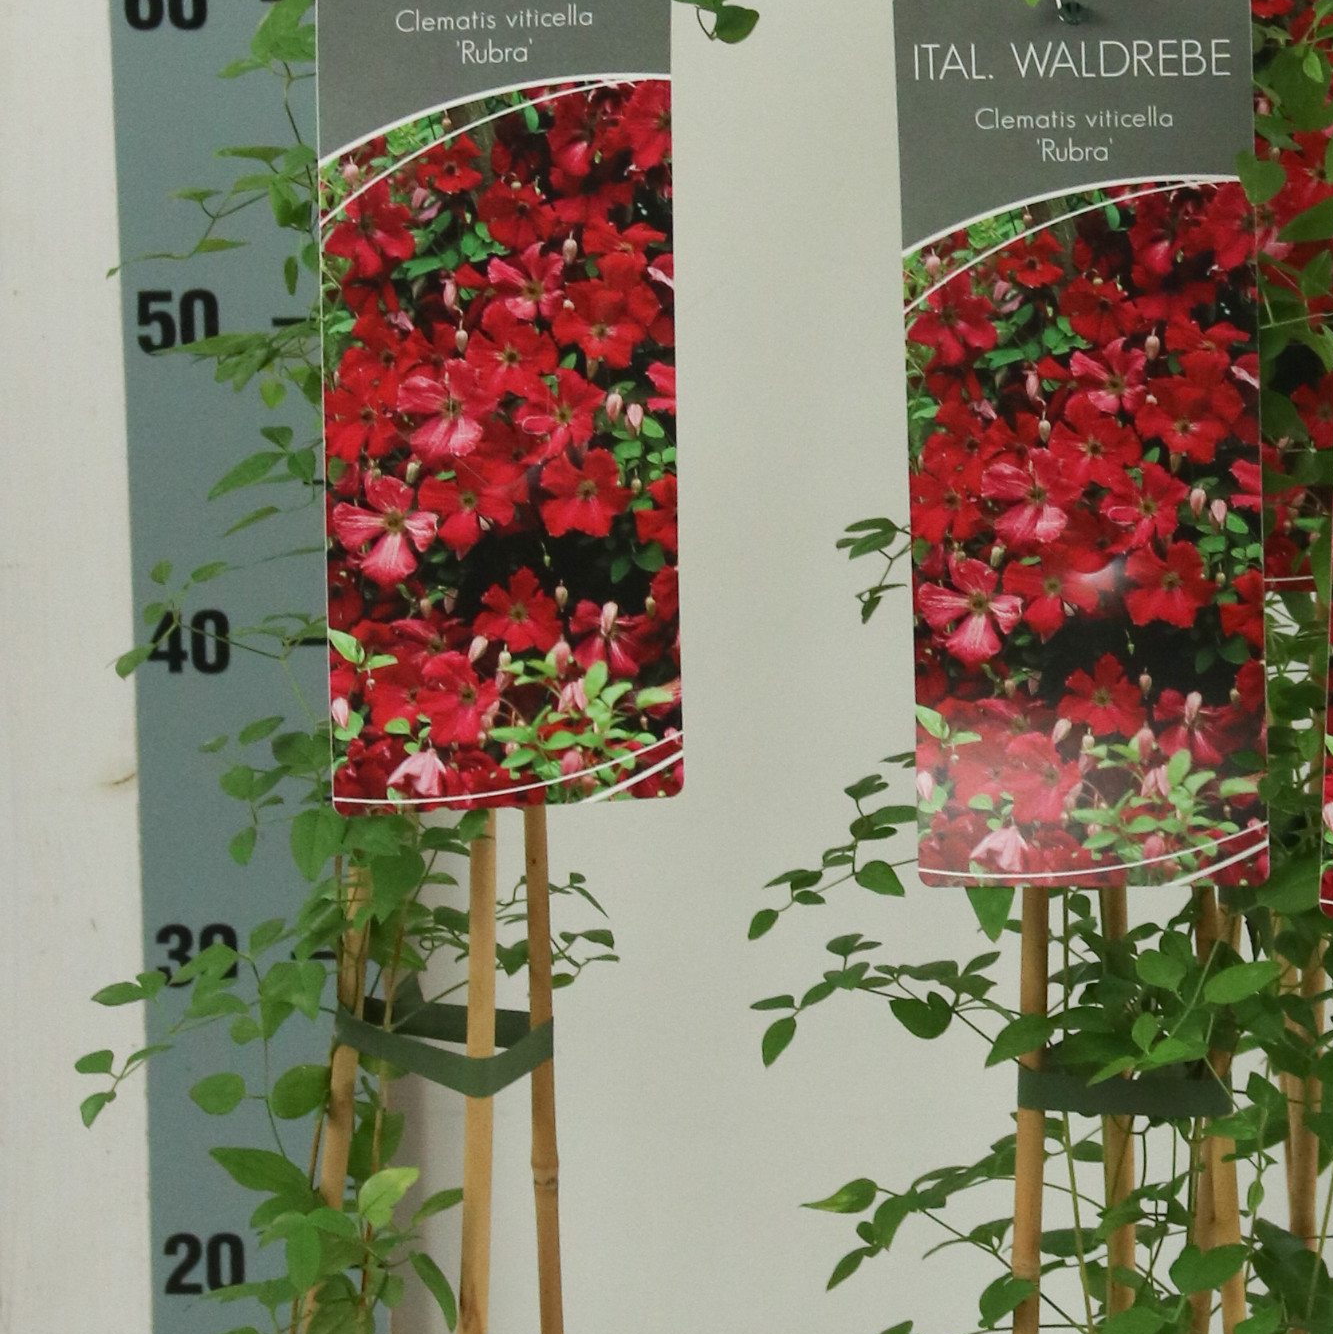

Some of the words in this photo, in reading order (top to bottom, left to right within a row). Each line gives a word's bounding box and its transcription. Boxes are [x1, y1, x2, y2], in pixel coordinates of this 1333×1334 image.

[395, 9, 496, 32] Clematis
[506, 4, 593, 28] viticella
[456, 38, 533, 64] 'Rubra'
[914, 43, 994, 80] ITAL.
[1010, 39, 1231, 78] WALDREBE
[975, 108, 1076, 130] Clematis
[1085, 105, 1173, 128] viticella
[1036, 137, 1113, 162] 'Rubra'
[137, 288, 219, 356] 50
[147, 609, 230, 675] 40
[164, 1232, 245, 1295] 20
